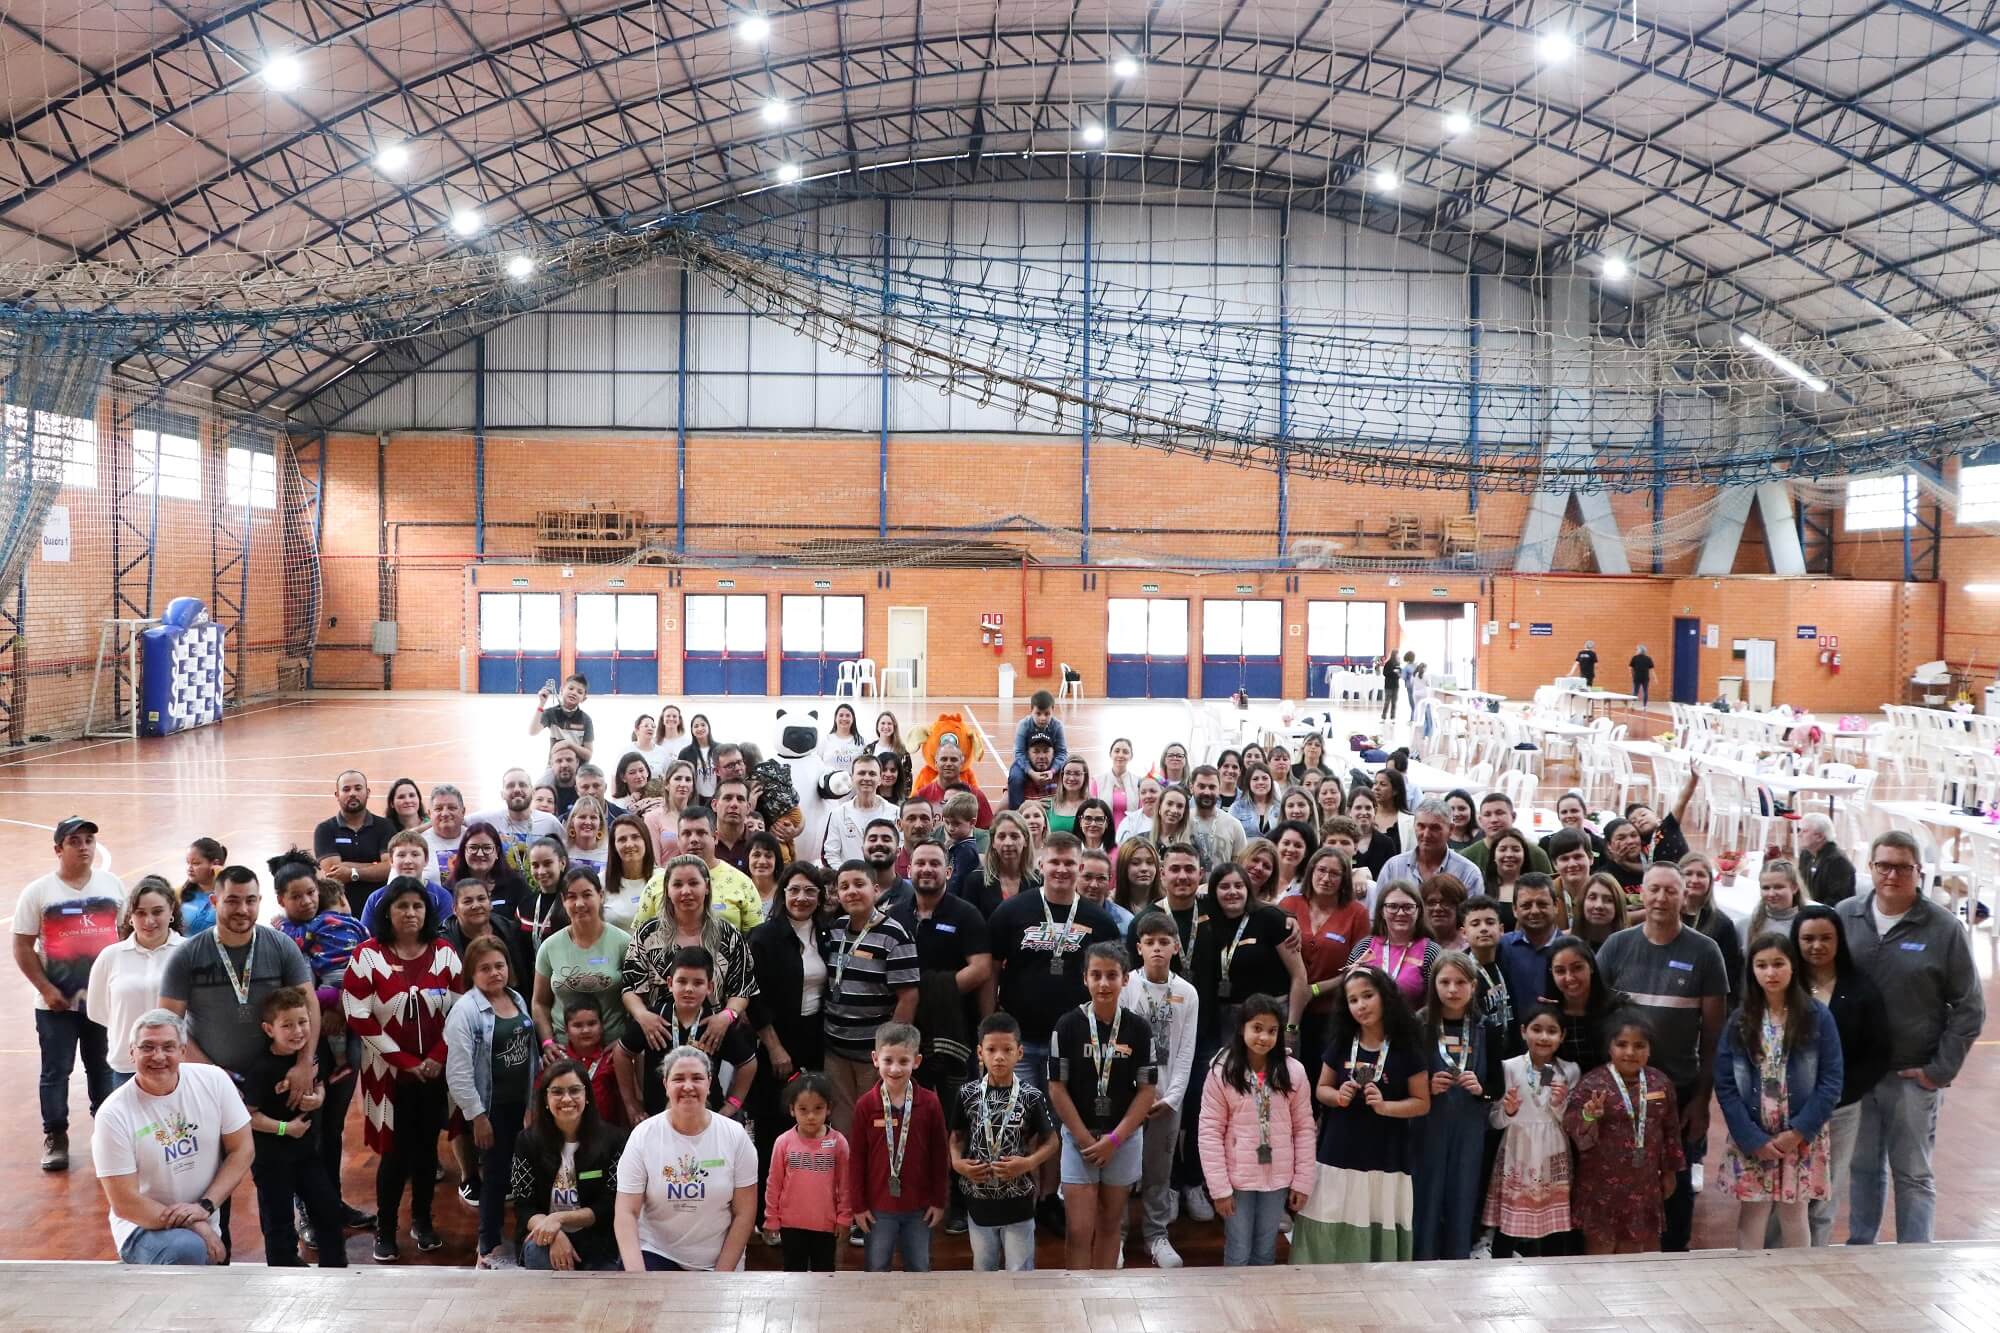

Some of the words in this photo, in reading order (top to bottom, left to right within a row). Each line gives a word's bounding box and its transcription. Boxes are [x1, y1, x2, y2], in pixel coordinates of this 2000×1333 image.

[164, 1136, 198, 1161] NCI
[555, 1189, 578, 1204] NC
[667, 1183, 705, 1199] NCI
